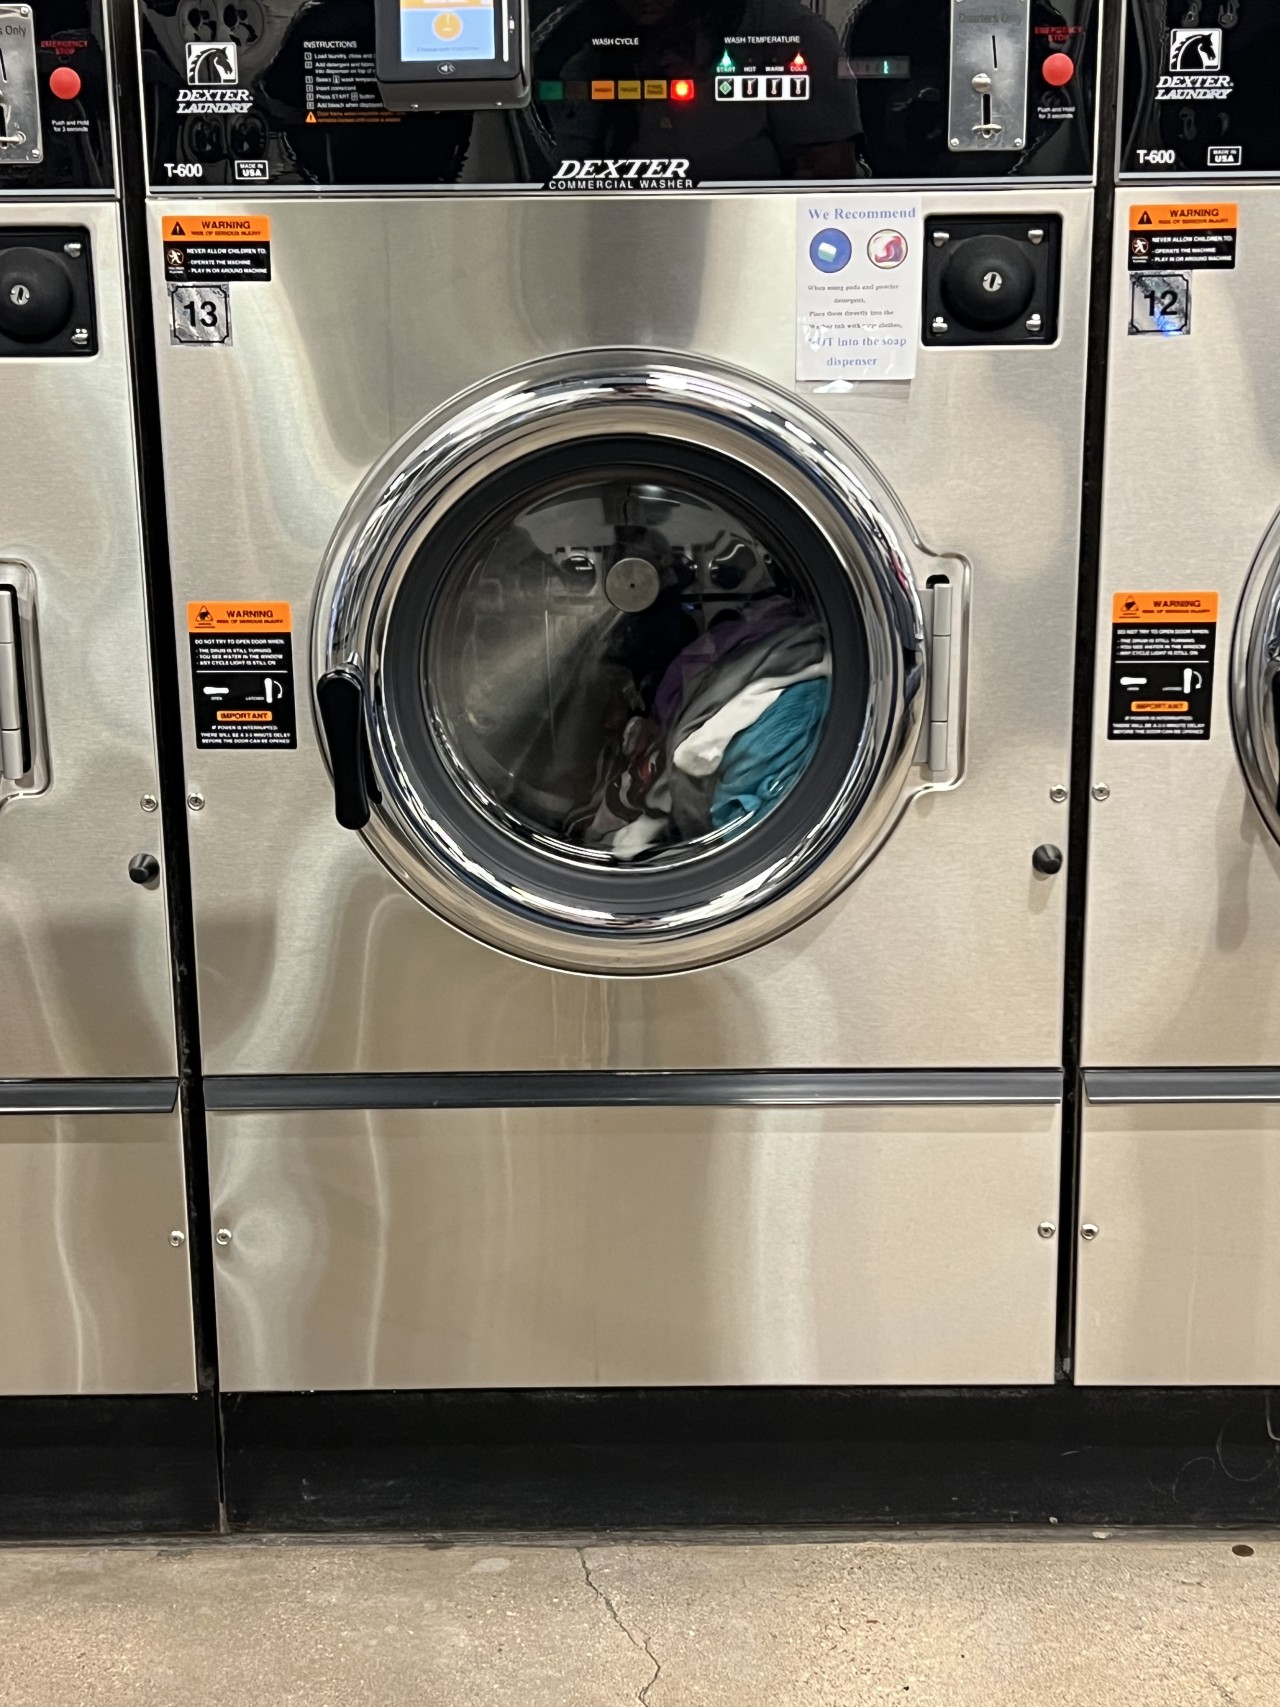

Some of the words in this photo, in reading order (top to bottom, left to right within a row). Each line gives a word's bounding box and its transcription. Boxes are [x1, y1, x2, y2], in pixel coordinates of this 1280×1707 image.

[5, 26, 26, 37] Only
[724, 36, 746, 44] WASH
[1156, 76, 1230, 87] DEXTER
[176, 89, 250, 101] DEXTER
[1155, 89, 1233, 99] LAUNDRY
[176, 103, 253, 113] LAUNDRY
[1137, 150, 1176, 163] T-600
[164, 163, 203, 177] T-600
[242, 169, 262, 177] USA
[552, 159, 690, 179] DEXTER
[549, 180, 633, 190] COMMERCIAL
[640, 180, 692, 190] WASHER
[809, 208, 829, 220] We
[835, 207, 915, 219] Recommend
[1170, 209, 1219, 217] WARNING
[202, 221, 250, 229] WARNING
[1144, 291, 1178, 316] 12
[184, 301, 218, 327] 13
[838, 338, 859, 346] into
[863, 337, 879, 346] the
[882, 338, 907, 347] soap
[827, 357, 877, 368] dispenser
[1153, 600, 1201, 608] WARNING
[227, 610, 273, 618] WARNING
